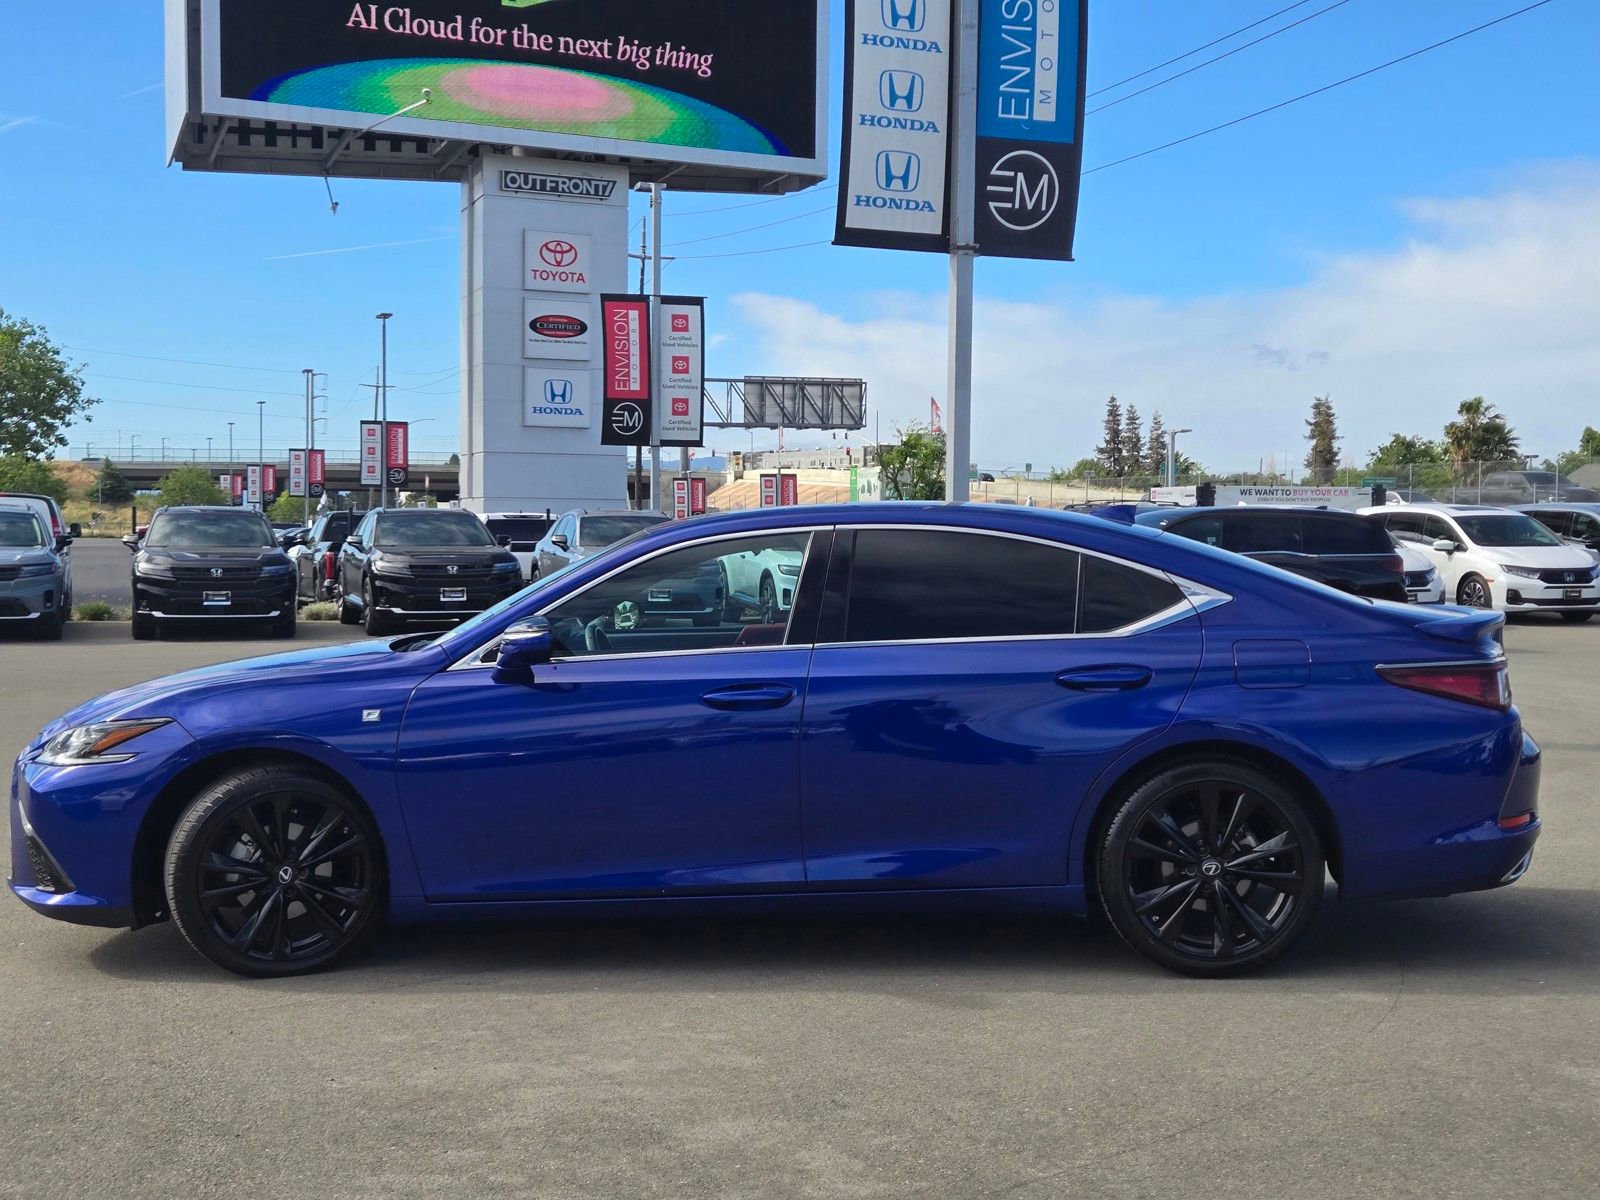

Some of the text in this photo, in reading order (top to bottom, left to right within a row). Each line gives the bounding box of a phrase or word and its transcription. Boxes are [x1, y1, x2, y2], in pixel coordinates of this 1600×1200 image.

[346, 3, 714, 77] AI Cloud for the next big thing
[861, 33, 943, 53] HONDA
[859, 114, 940, 133] HONDA
[854, 195, 936, 212] HONDA
[531, 269, 586, 283] TOYOTA
[613, 309, 629, 391] ENVISION
[532, 406, 584, 416] HONDA
[1333, 489, 1349, 497] CAR
